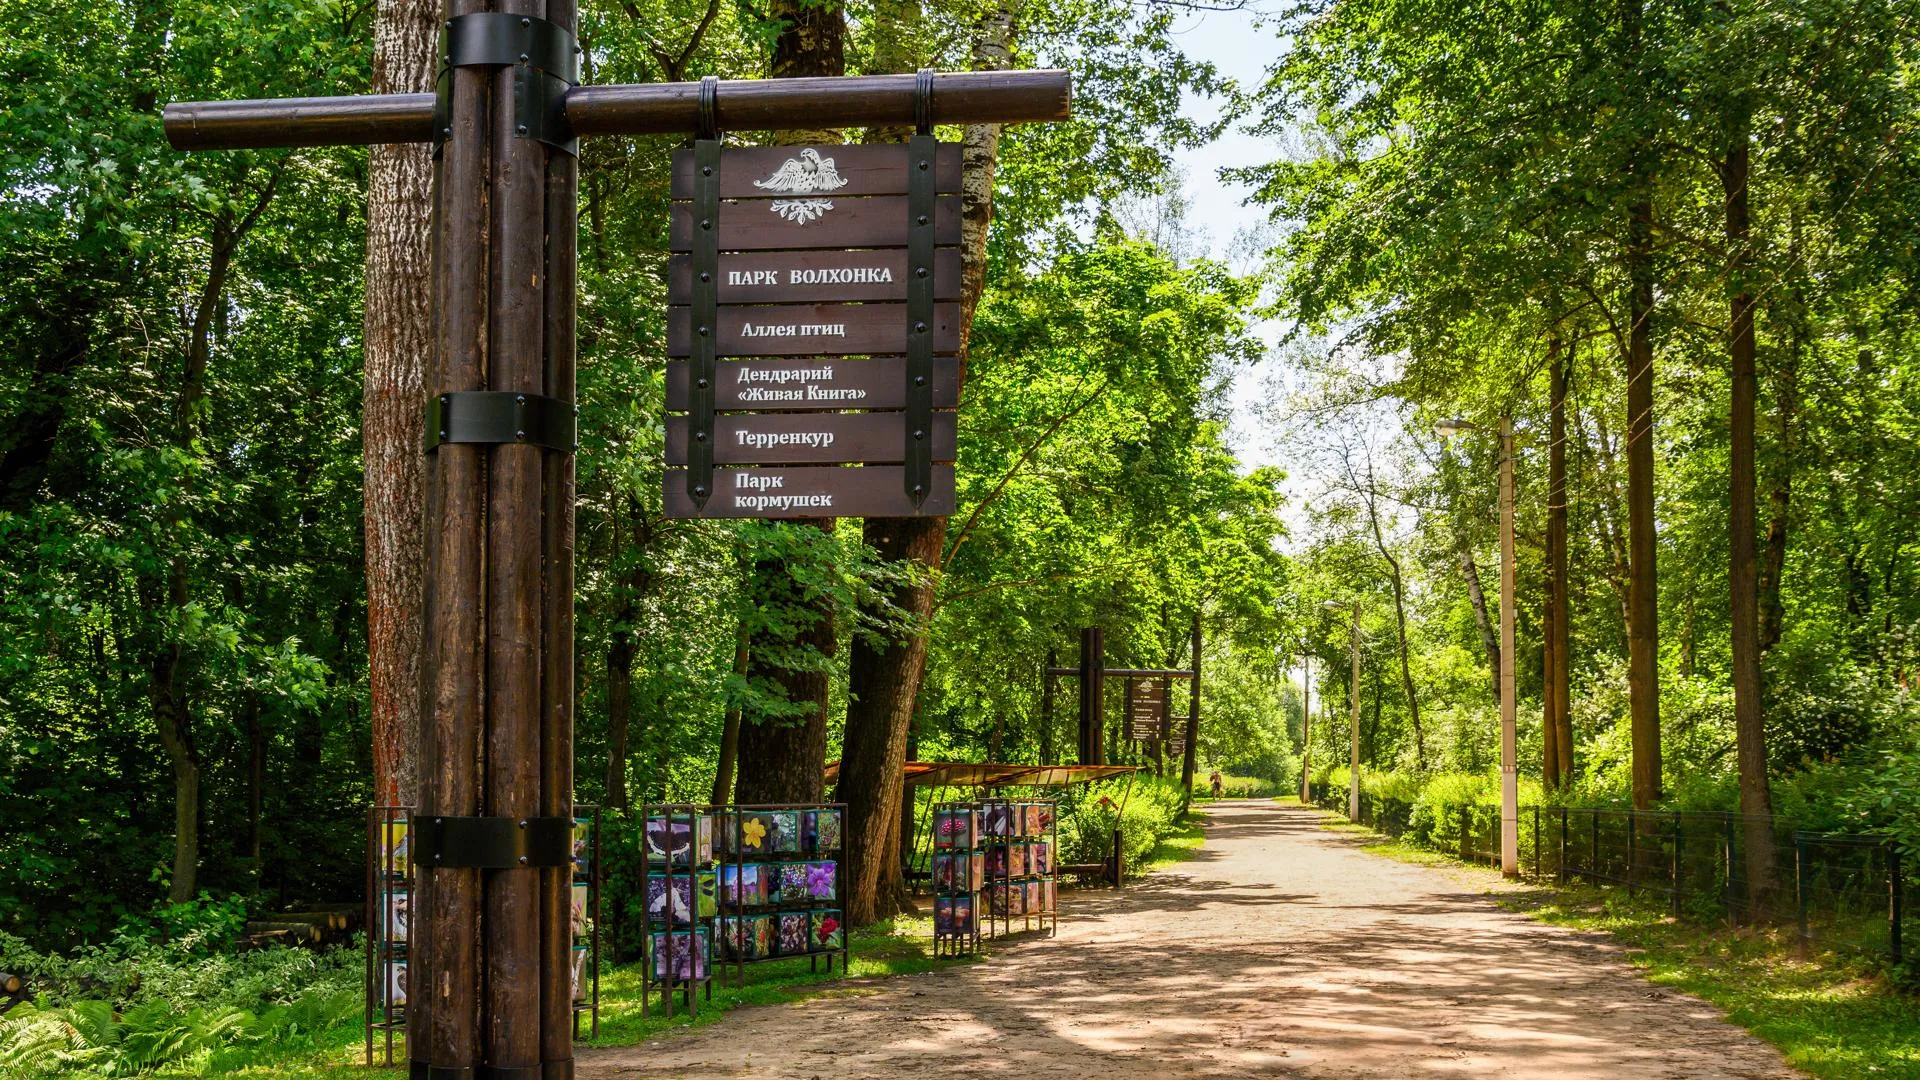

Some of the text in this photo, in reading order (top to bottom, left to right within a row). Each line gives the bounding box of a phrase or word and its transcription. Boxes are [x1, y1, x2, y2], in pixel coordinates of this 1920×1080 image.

[728, 267, 893, 286] ПАРК ВОЛХОНКА
[740, 322, 845, 338] Аллея птиц
[737, 366, 833, 384] Дендрарий
[737, 385, 867, 401] «Живая Книга»
[735, 430, 834, 449] Терренкур
[735, 473, 783, 492] Парк
[735, 494, 833, 511] кормушек
